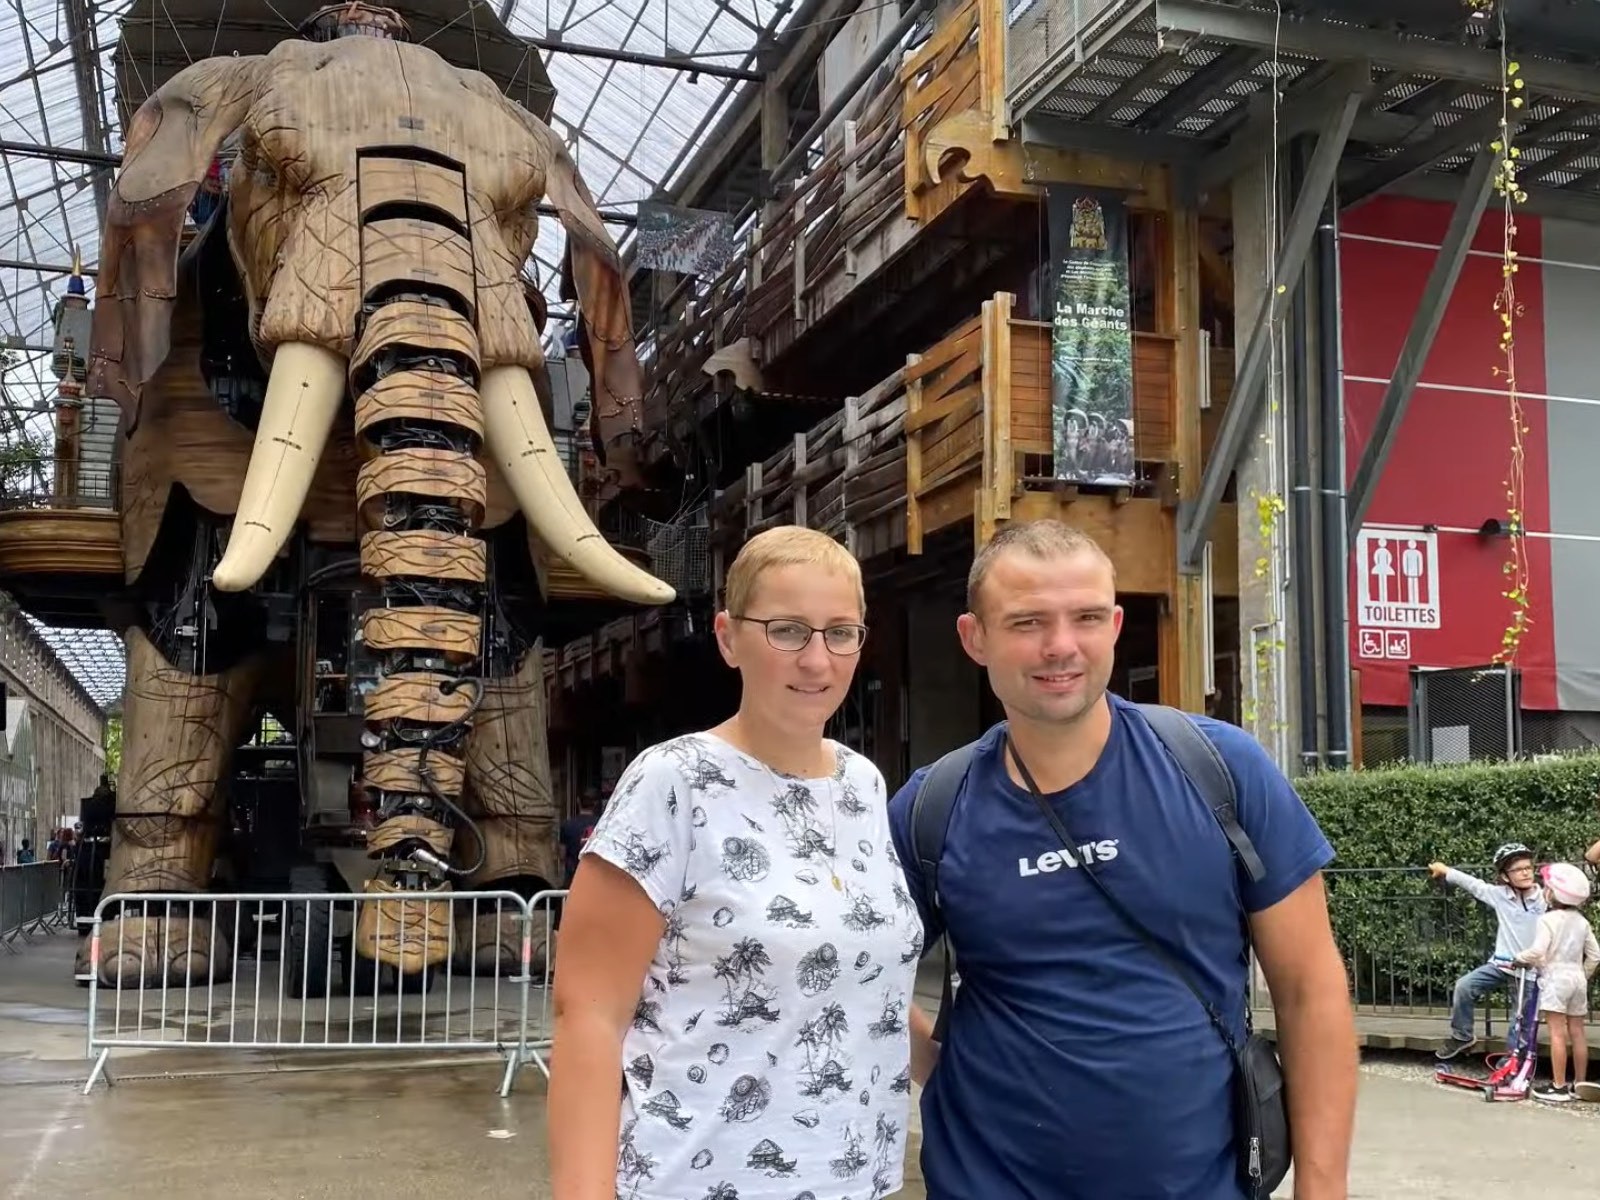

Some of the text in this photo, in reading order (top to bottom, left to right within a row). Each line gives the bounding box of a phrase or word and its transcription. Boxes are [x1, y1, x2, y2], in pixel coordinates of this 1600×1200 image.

[1056, 301, 1125, 317] La Marche
[1054, 315, 1128, 331] des Géants
[1364, 605, 1436, 623] TOILETTES
